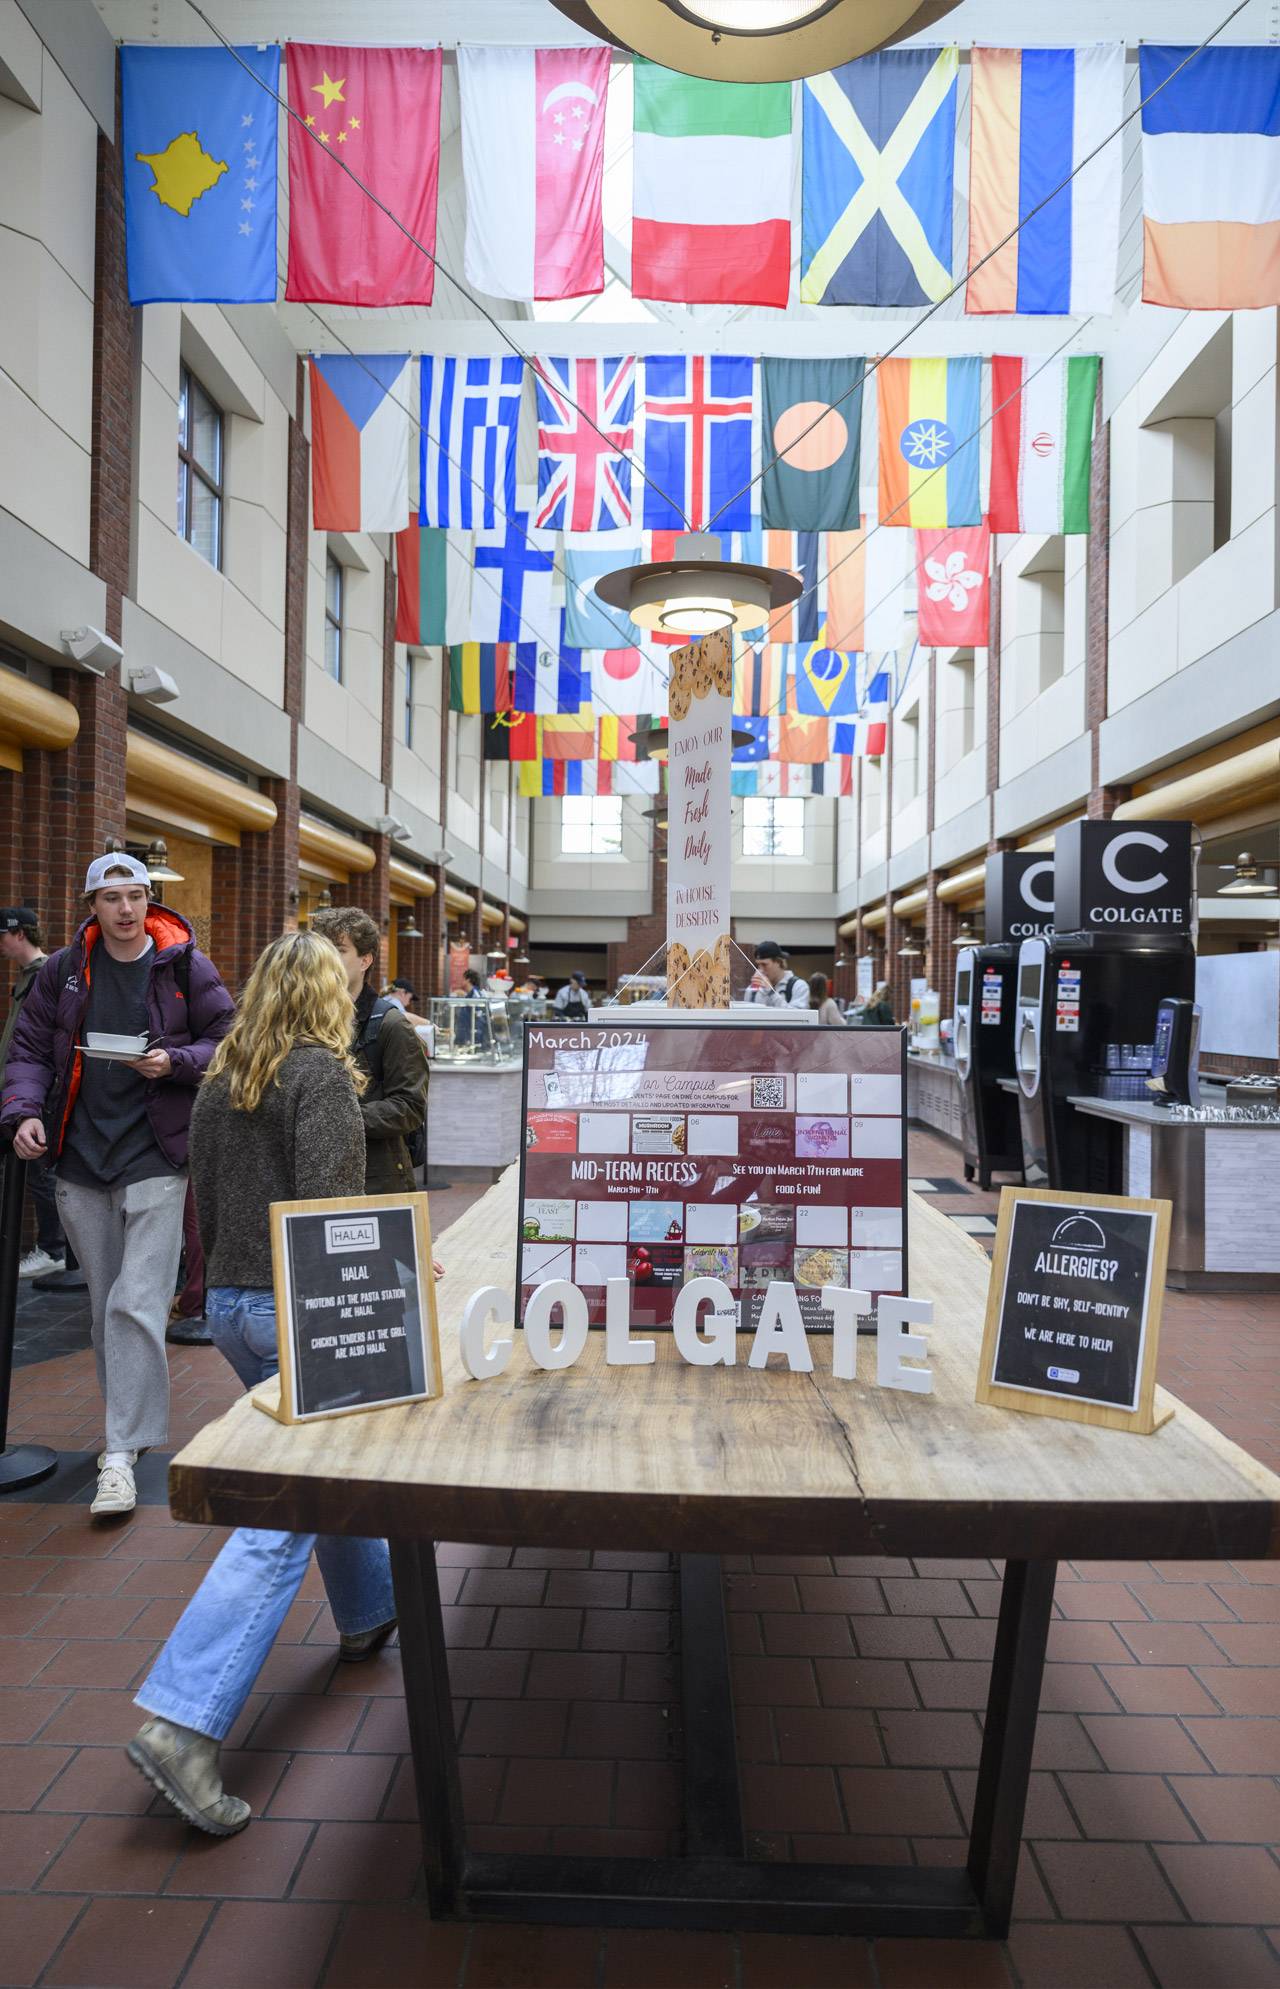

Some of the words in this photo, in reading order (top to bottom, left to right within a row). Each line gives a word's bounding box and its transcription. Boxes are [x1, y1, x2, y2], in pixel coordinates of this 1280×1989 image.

[675, 736, 698, 757] ENJOY
[704, 726, 723, 745] OUR
[684, 761, 712, 790] Made
[684, 789, 710, 824] Fresh
[684, 830, 712, 866] Daily
[676, 908, 720, 928] DESSERTS
[1090, 907, 1183, 924] COLGATE
[528, 1031, 591, 1049] March
[597, 1032, 646, 1050] 2024
[664, 1075, 716, 1096] Campus
[571, 1160, 642, 1180] MID-TERM
[646, 1161, 698, 1182] RECESS
[796, 1184, 802, 1194] &
[334, 1229, 371, 1241] HALAL
[341, 1265, 370, 1282] HALAL
[1034, 1252, 1119, 1282] ALLERGIES?
[306, 1296, 335, 1310] PROTEINS
[337, 1295, 346, 1306] AT
[347, 1294, 359, 1304] THE
[360, 1291, 380, 1303] PASTA
[381, 1288, 406, 1300] STATION
[1018, 1292, 1040, 1306] DON'T
[1042, 1295, 1052, 1308] BE
[1054, 1297, 1070, 1312] SHY,
[1073, 1300, 1130, 1319] SELF-IDENTIFY
[340, 1307, 353, 1319] ARE
[311, 1336, 338, 1350] CHICKEN
[339, 1332, 366, 1346] TENDERS
[367, 1330, 376, 1341] AT
[376, 1328, 389, 1340] THE
[390, 1326, 406, 1338] GRILL
[460, 1276, 935, 1394] COLGATE
[1024, 1327, 1036, 1340] WE
[1039, 1329, 1054, 1343] ARE
[1056, 1332, 1076, 1347] HERE
[1079, 1335, 1090, 1348] TO
[335, 1346, 348, 1360] ARE
[350, 1344, 366, 1357] ALSO
[367, 1342, 387, 1355] HALAL
